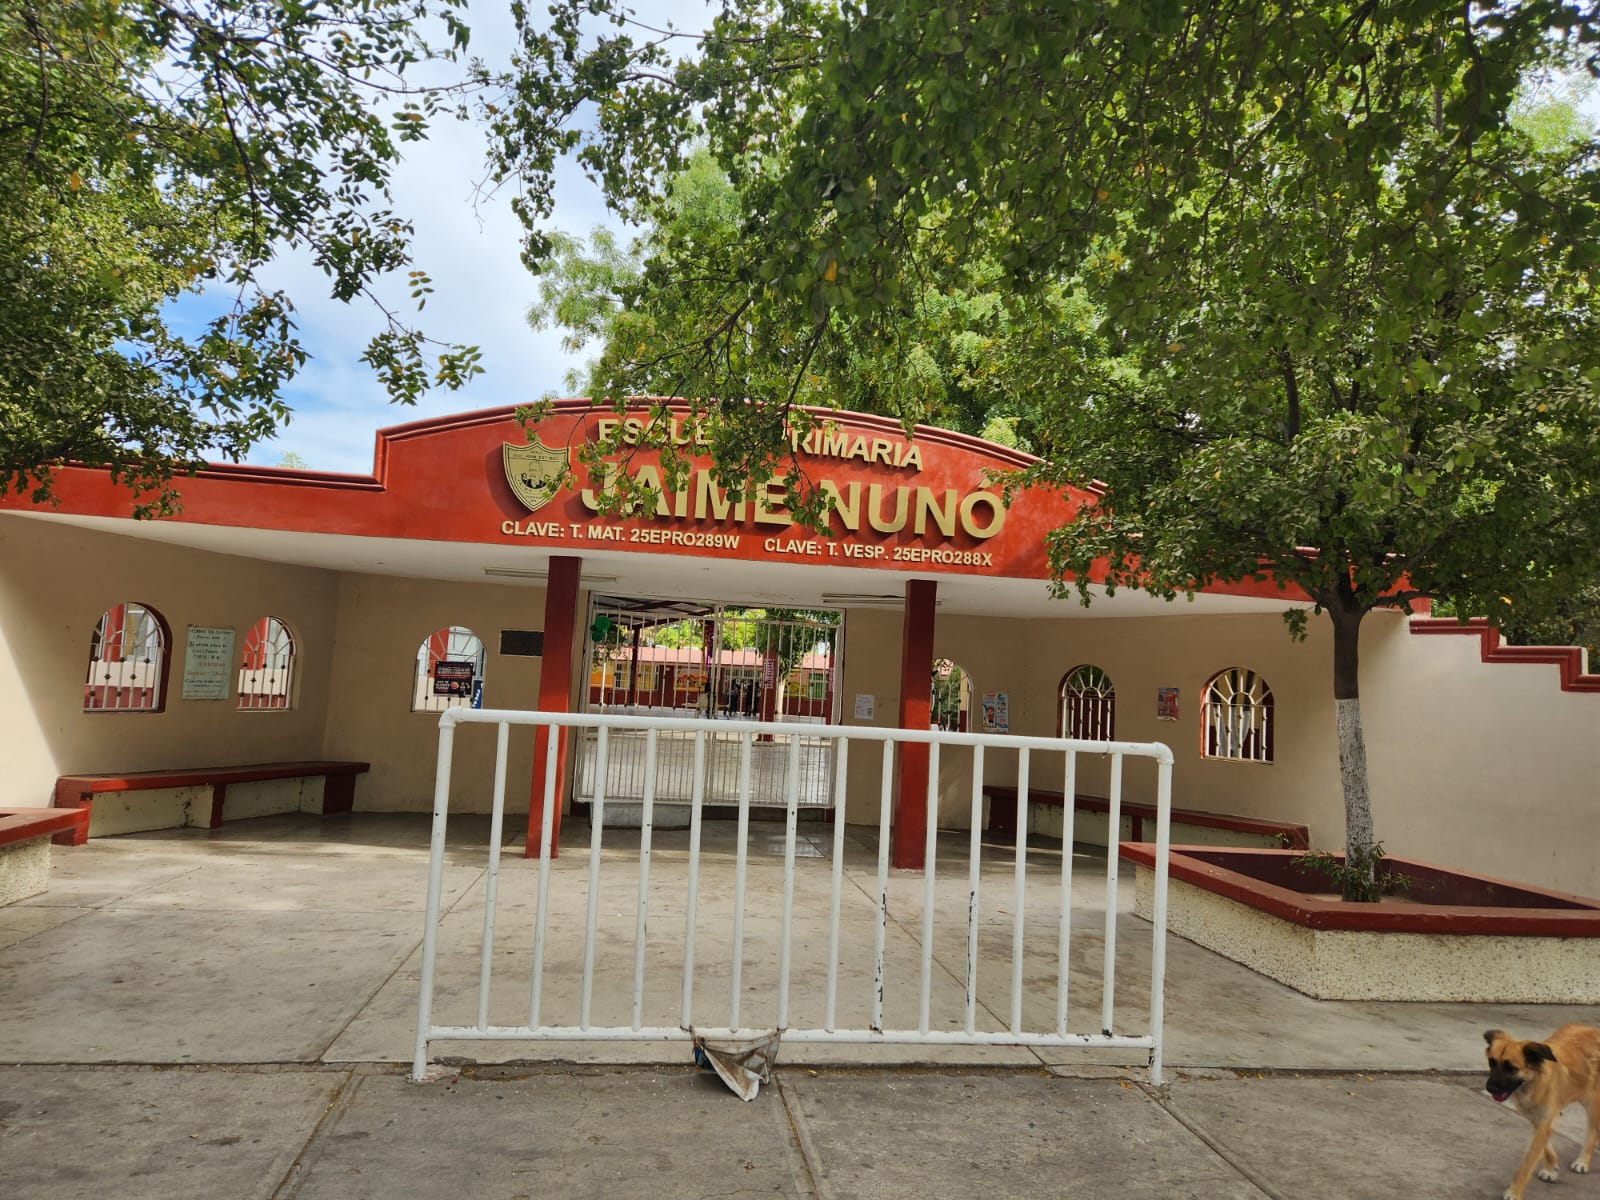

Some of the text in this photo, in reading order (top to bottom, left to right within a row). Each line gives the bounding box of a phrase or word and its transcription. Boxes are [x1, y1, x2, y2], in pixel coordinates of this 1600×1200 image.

[598, 418, 923, 472] ESCUE RIMARIA
[582, 462, 1006, 539] JAIME NUNÓ
[501, 520, 565, 538] CLAVE:
[570, 524, 583, 539] T.
[588, 525, 626, 542] MAT.
[764, 538, 822, 556] CLAVE:
[827, 542, 838, 556] T.
[843, 543, 889, 560] VESP.
